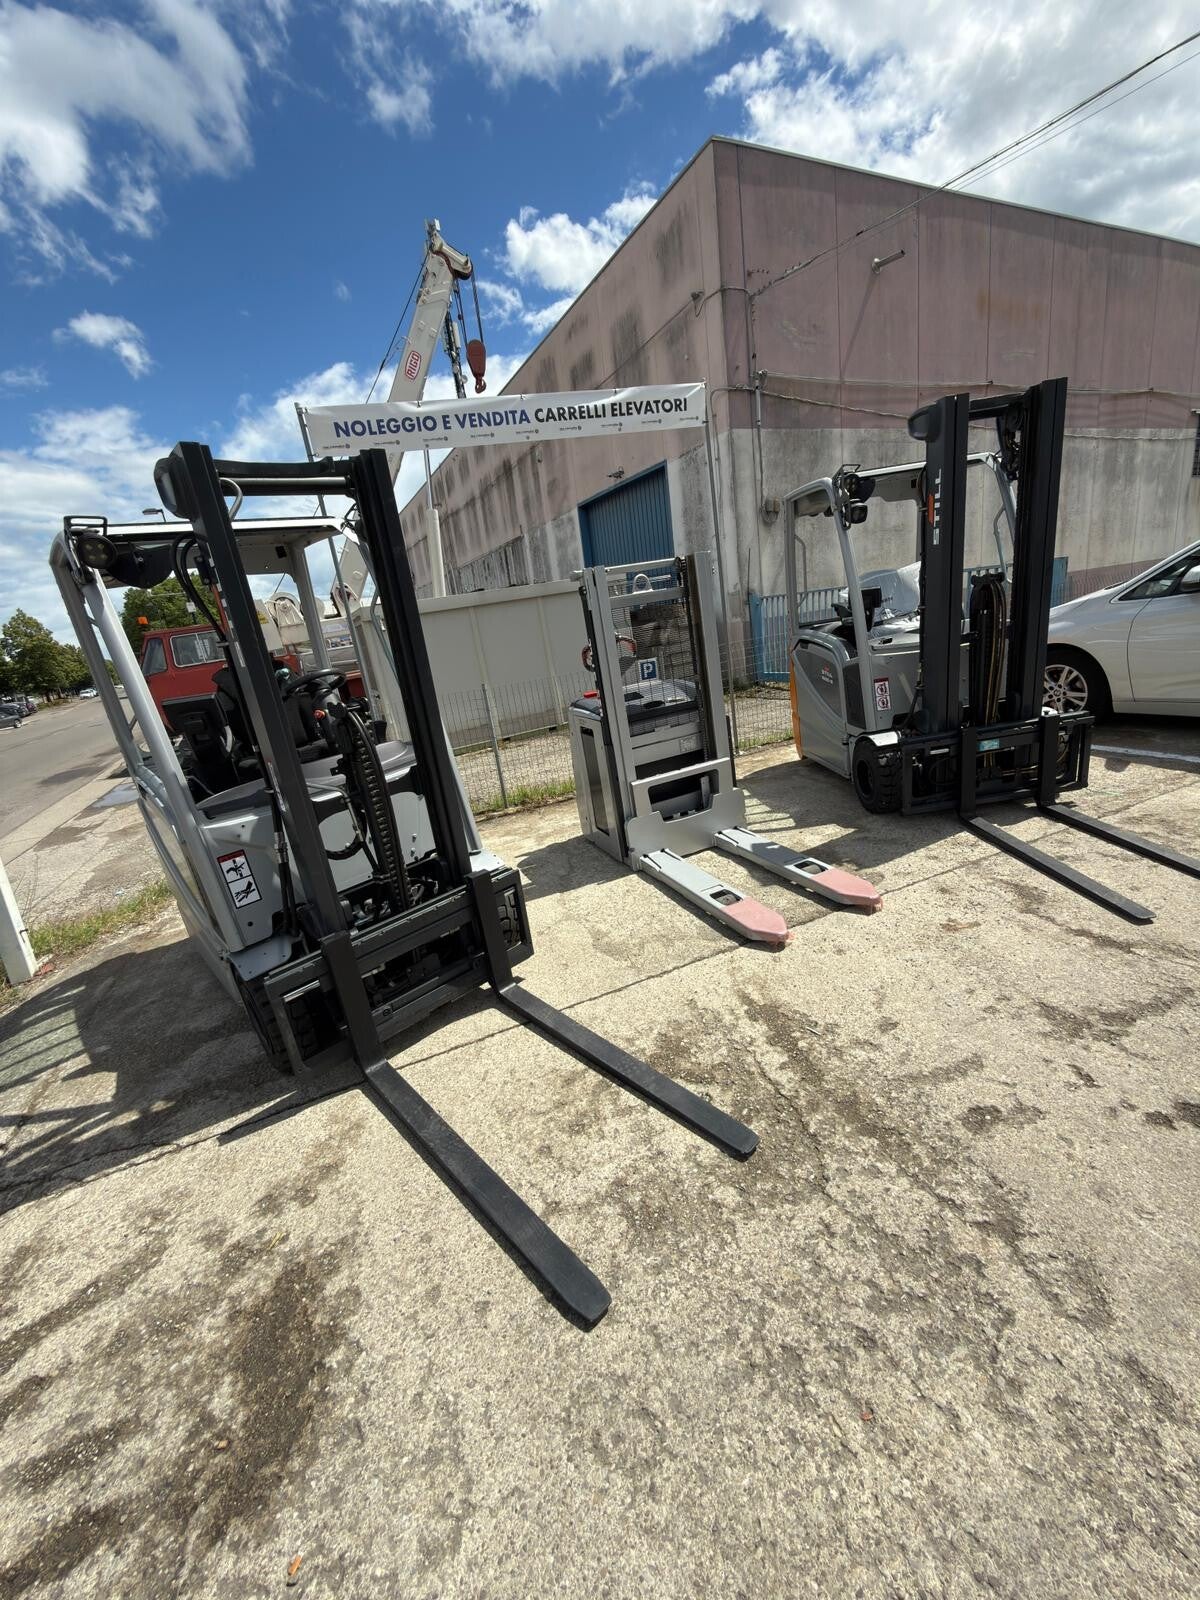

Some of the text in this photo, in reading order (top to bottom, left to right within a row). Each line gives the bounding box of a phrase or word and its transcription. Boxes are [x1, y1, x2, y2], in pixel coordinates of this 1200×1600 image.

[406, 352, 420, 378] RIGO
[333, 397, 688, 438] NOLEGGIO E VENDITA CARRELLI ELEVATORI
[933, 468, 942, 545] STILL
[643, 662, 654, 678] P
